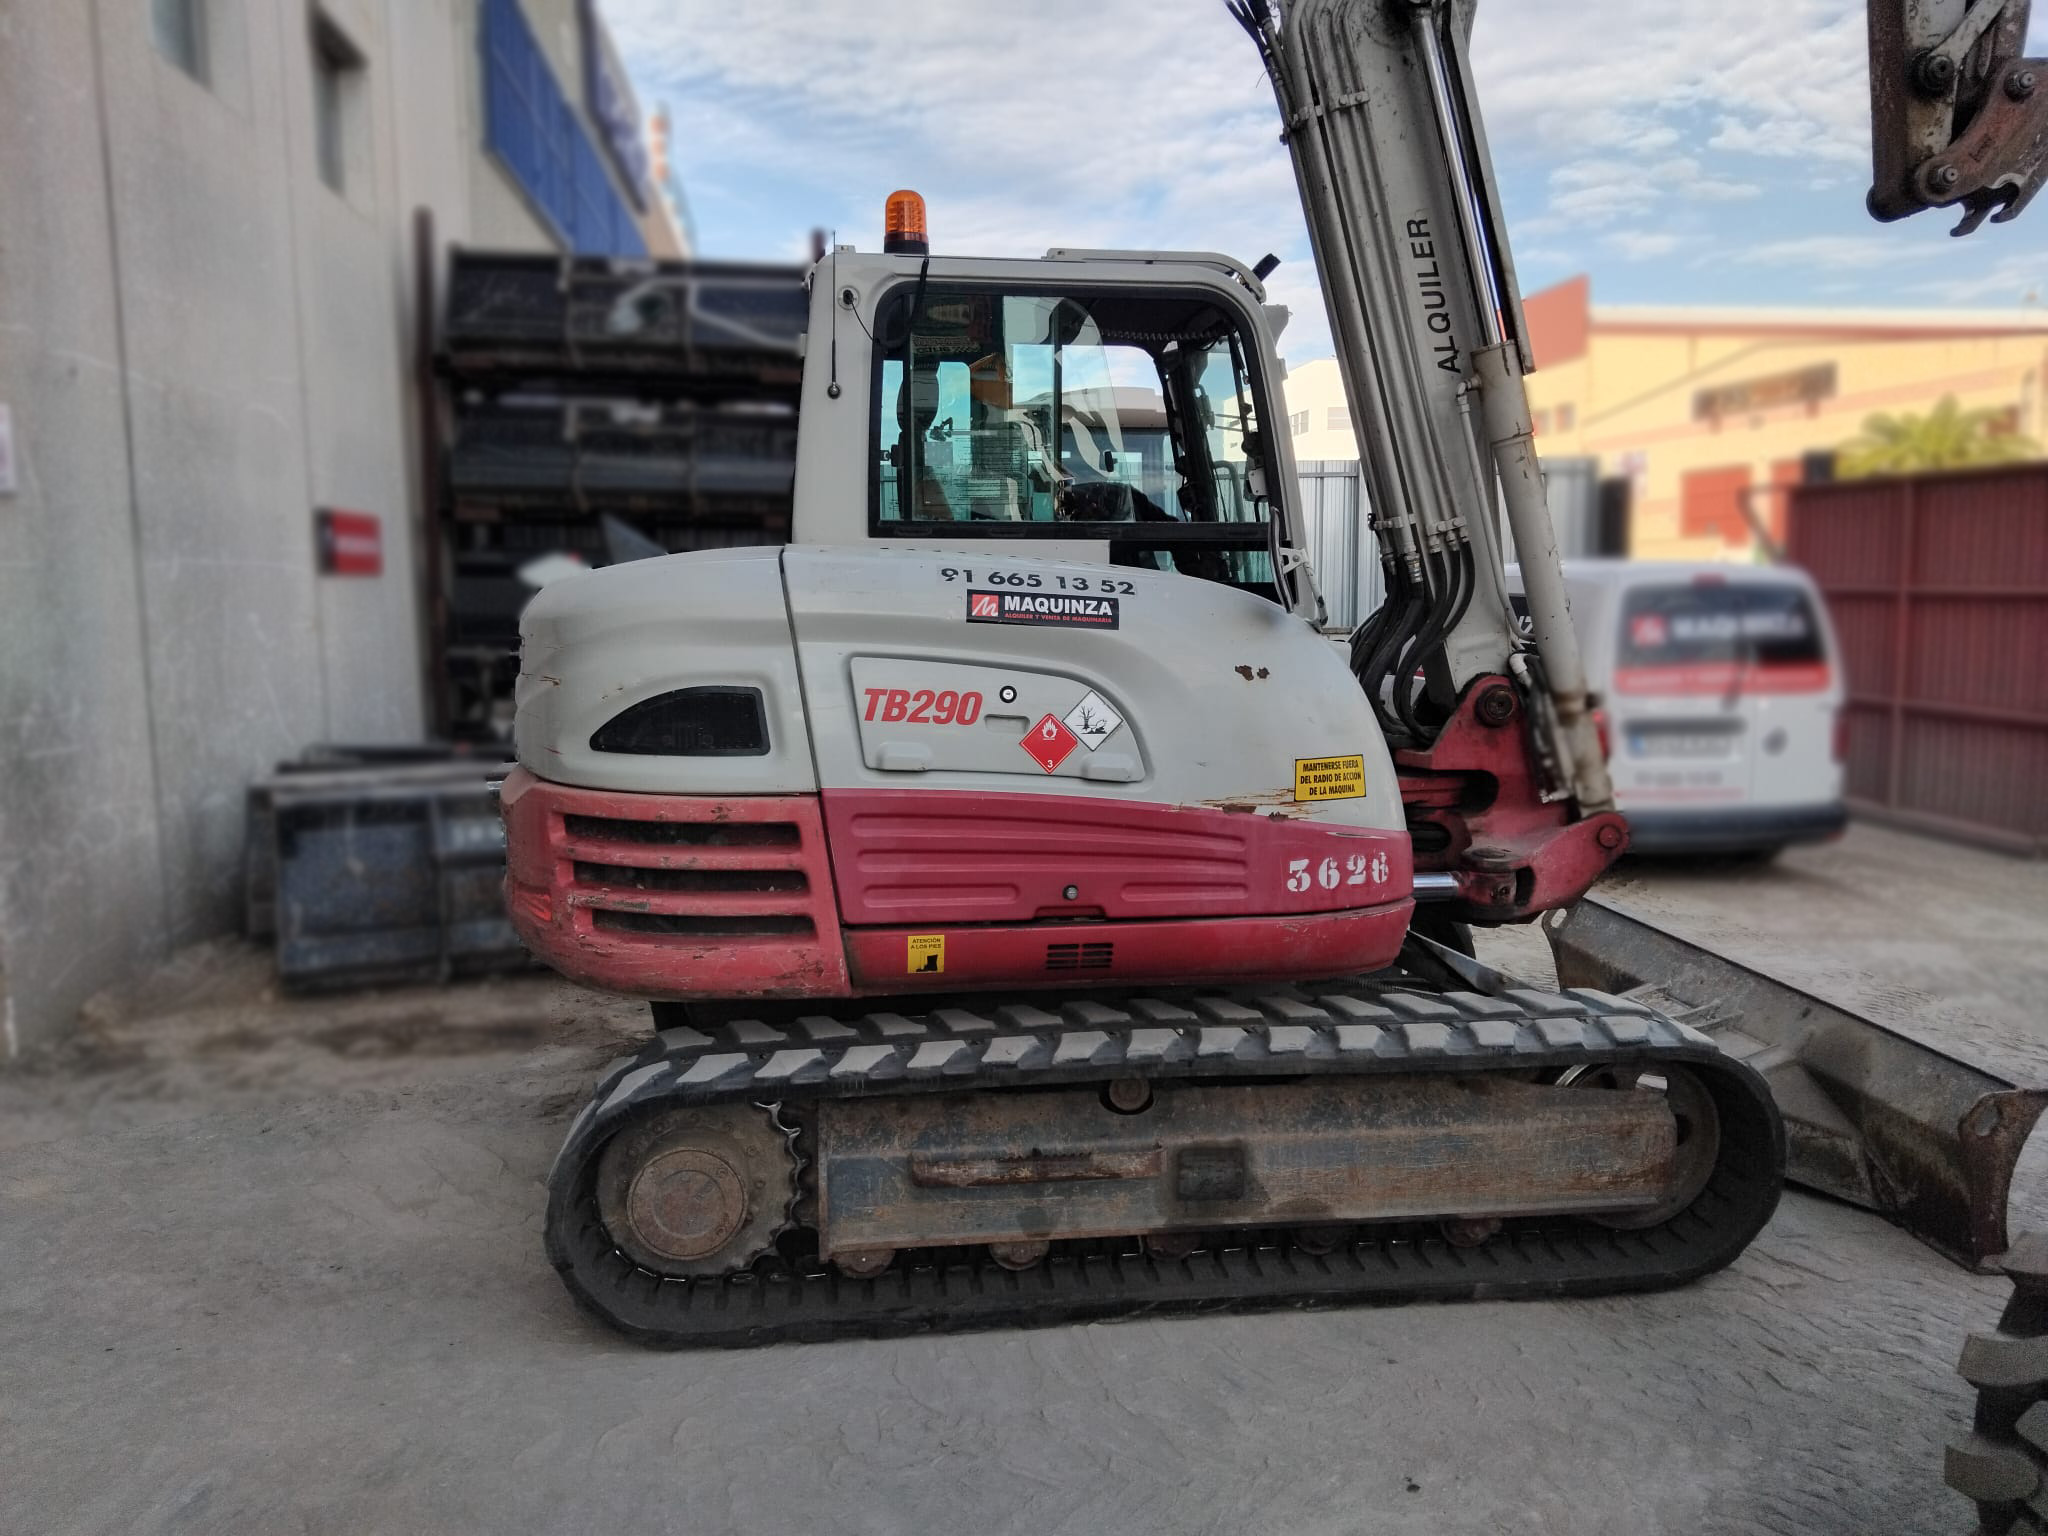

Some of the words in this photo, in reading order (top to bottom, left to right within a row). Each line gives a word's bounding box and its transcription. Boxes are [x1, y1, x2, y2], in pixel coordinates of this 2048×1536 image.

[1406, 219, 1461, 374] ALQUILER
[941, 567, 973, 583] 91
[988, 571, 1042, 588] 665
[1056, 576, 1089, 591] 13
[1100, 579, 1135, 596] 52
[1004, 595, 1113, 616] MAQUINZA
[1004, 612, 1033, 620] ALQUILER
[863, 687, 984, 726] TB290
[1047, 759, 1054, 769] 3
[1303, 761, 1341, 773] MANTENERSE
[1342, 759, 1359, 769] FUERA
[1300, 775, 1312, 784] DEL
[1313, 773, 1333, 783] RADIO
[1334, 773, 1342, 782] DE
[1309, 786, 1318, 796] DE
[1319, 786, 1327, 795] LA
